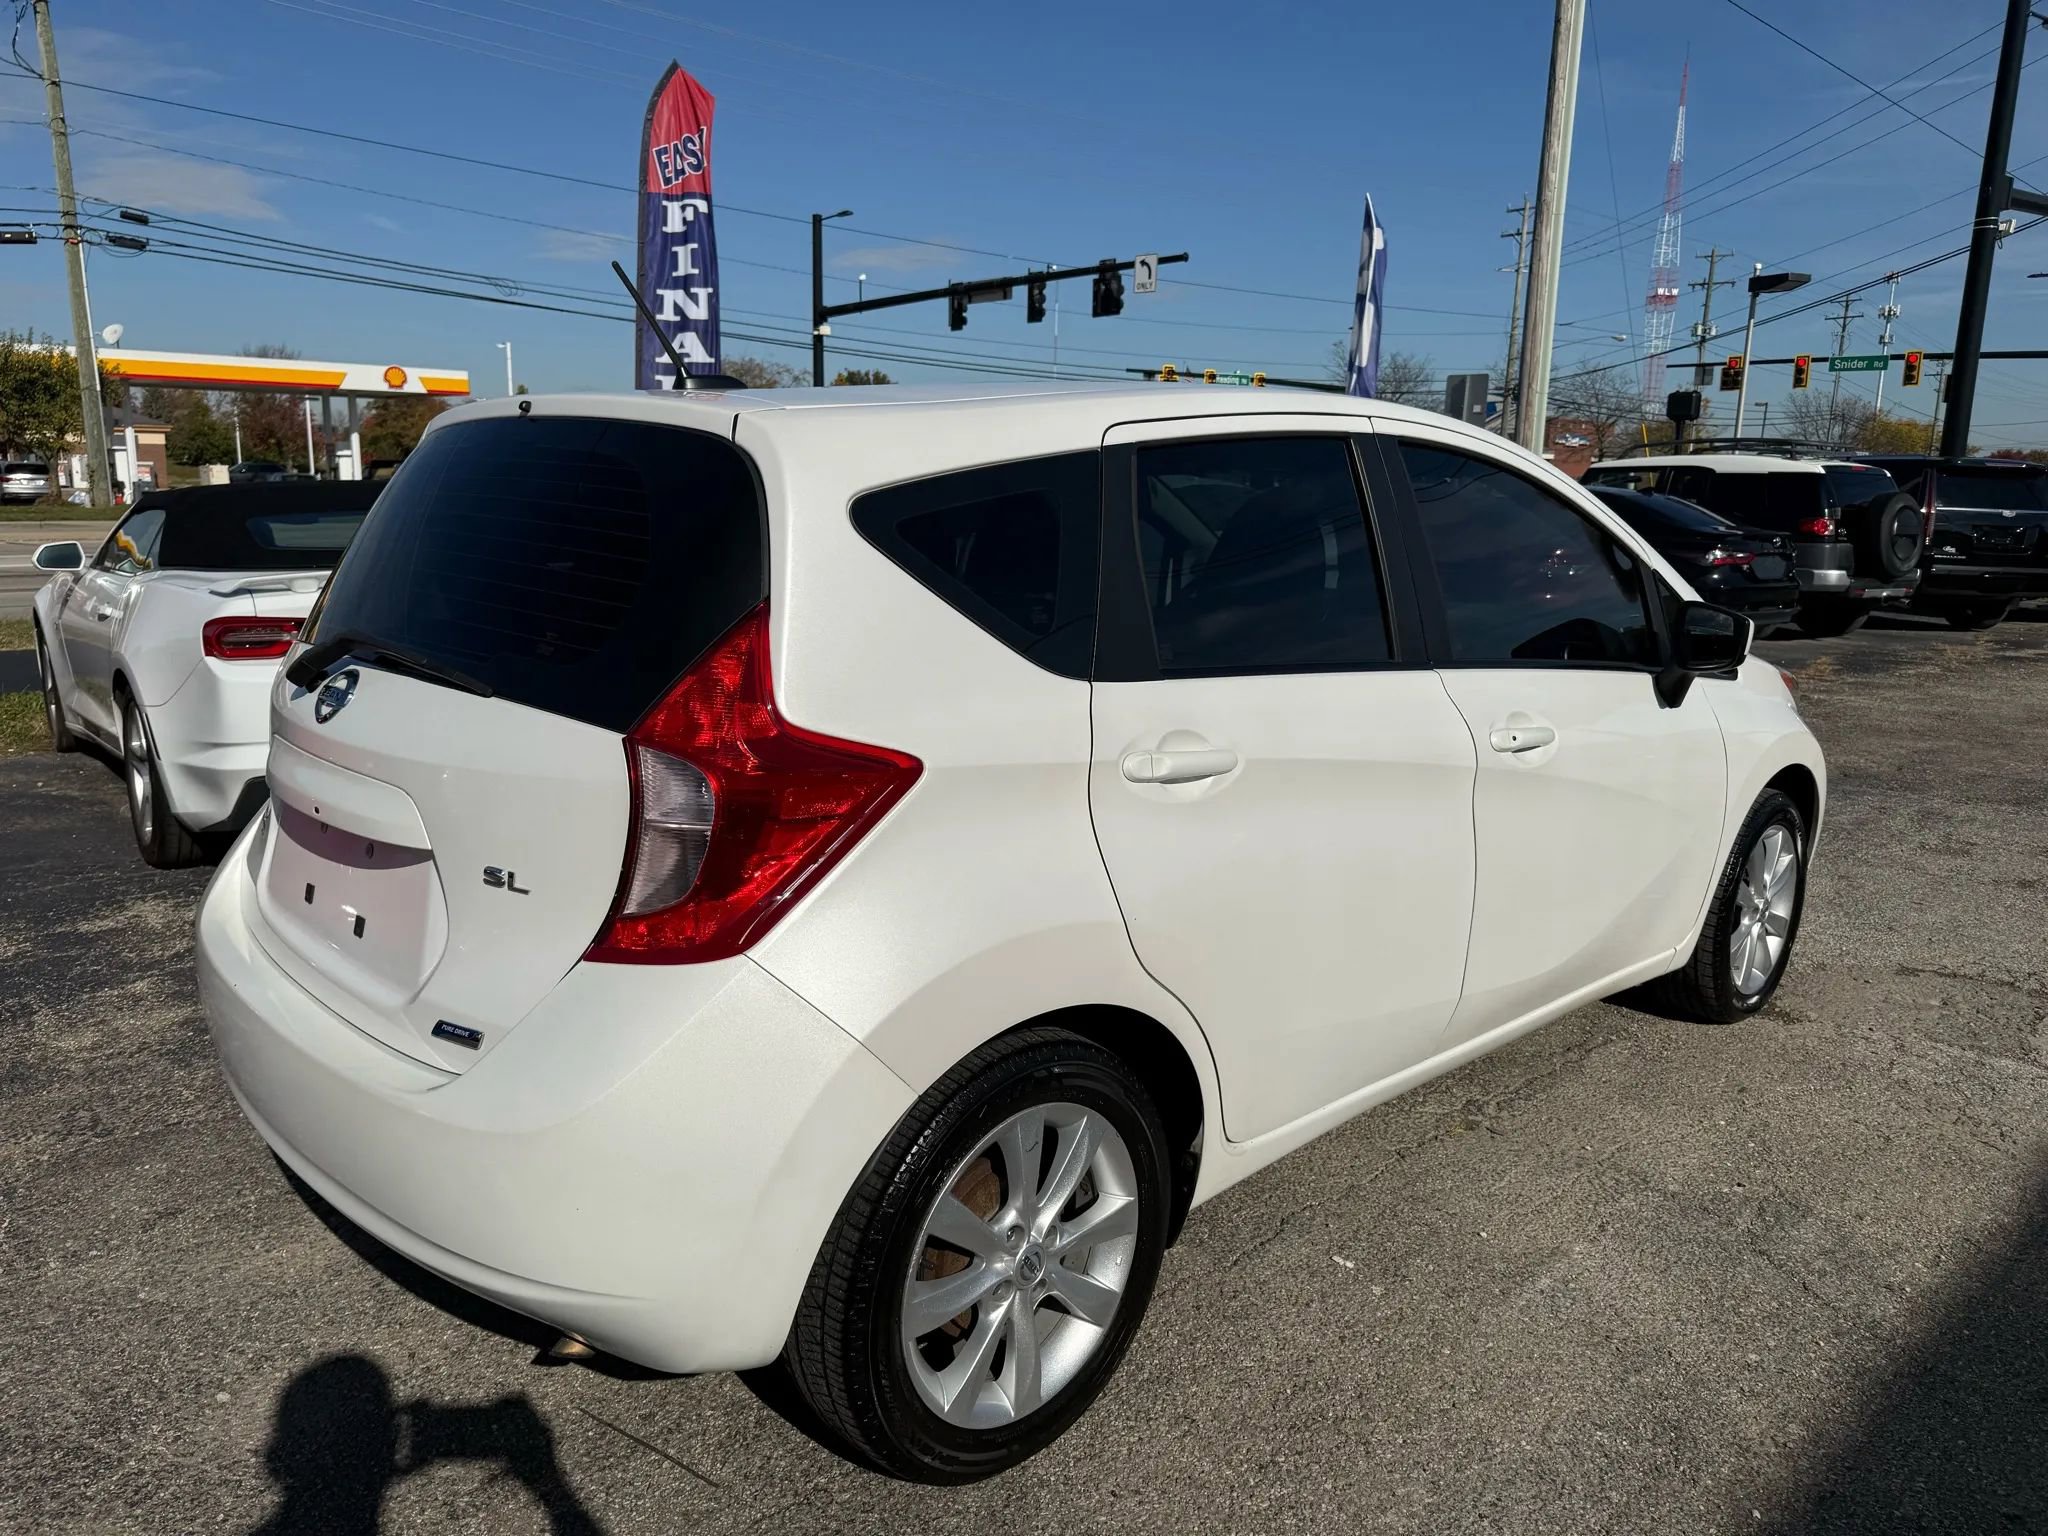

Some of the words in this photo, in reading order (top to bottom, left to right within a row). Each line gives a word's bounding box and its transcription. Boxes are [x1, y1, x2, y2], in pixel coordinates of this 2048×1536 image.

[1136, 281, 1154, 291] ONLY
[1834, 359, 1868, 369] Snider
[1873, 360, 1884, 368] Rd
[483, 865, 532, 896] SL
